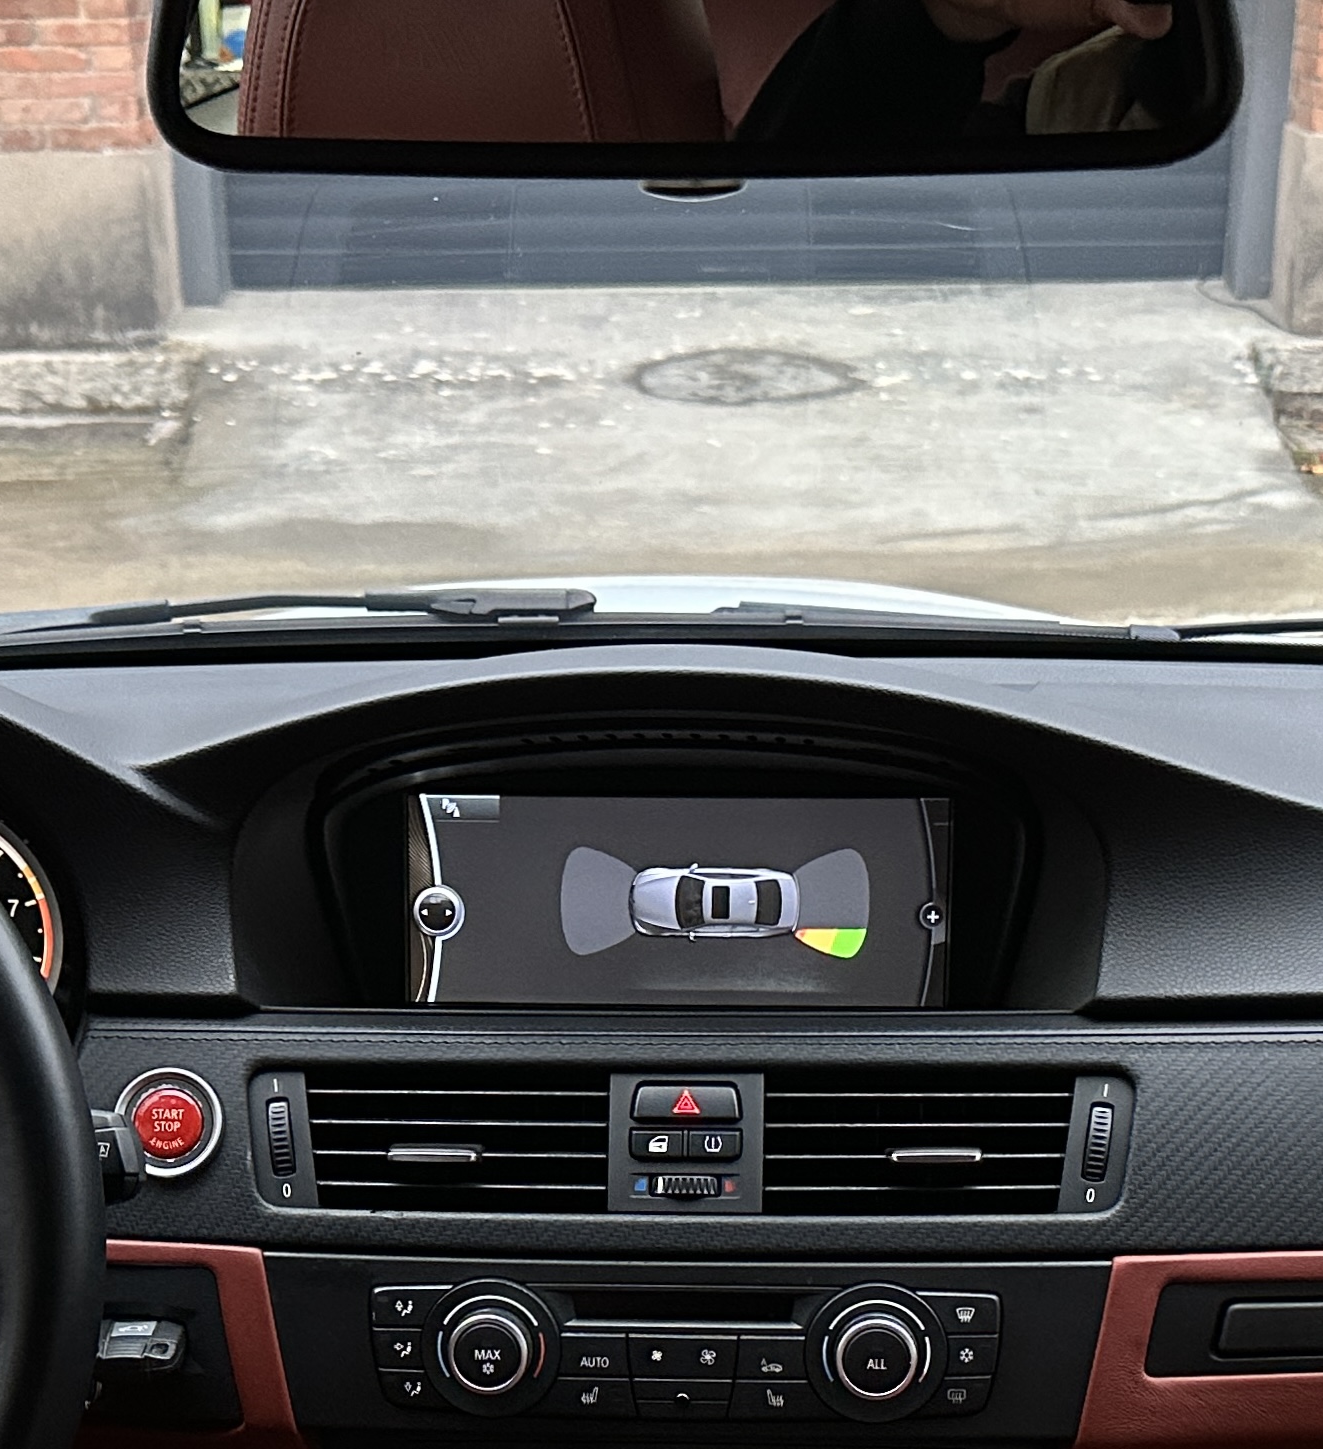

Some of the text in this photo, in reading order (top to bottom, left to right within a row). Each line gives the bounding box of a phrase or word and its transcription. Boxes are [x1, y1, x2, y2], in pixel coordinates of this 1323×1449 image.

[7, 899, 19, 917] 7
[151, 1109, 184, 1120] START
[153, 1121, 181, 1132] STOP
[149, 1136, 185, 1150] ENGINE
[282, 1183, 292, 1198] 0
[1086, 1188, 1095, 1202] 0
[474, 1350, 501, 1361] MAX
[580, 1356, 610, 1368] AUTO
[866, 1358, 888, 1370] ALL
